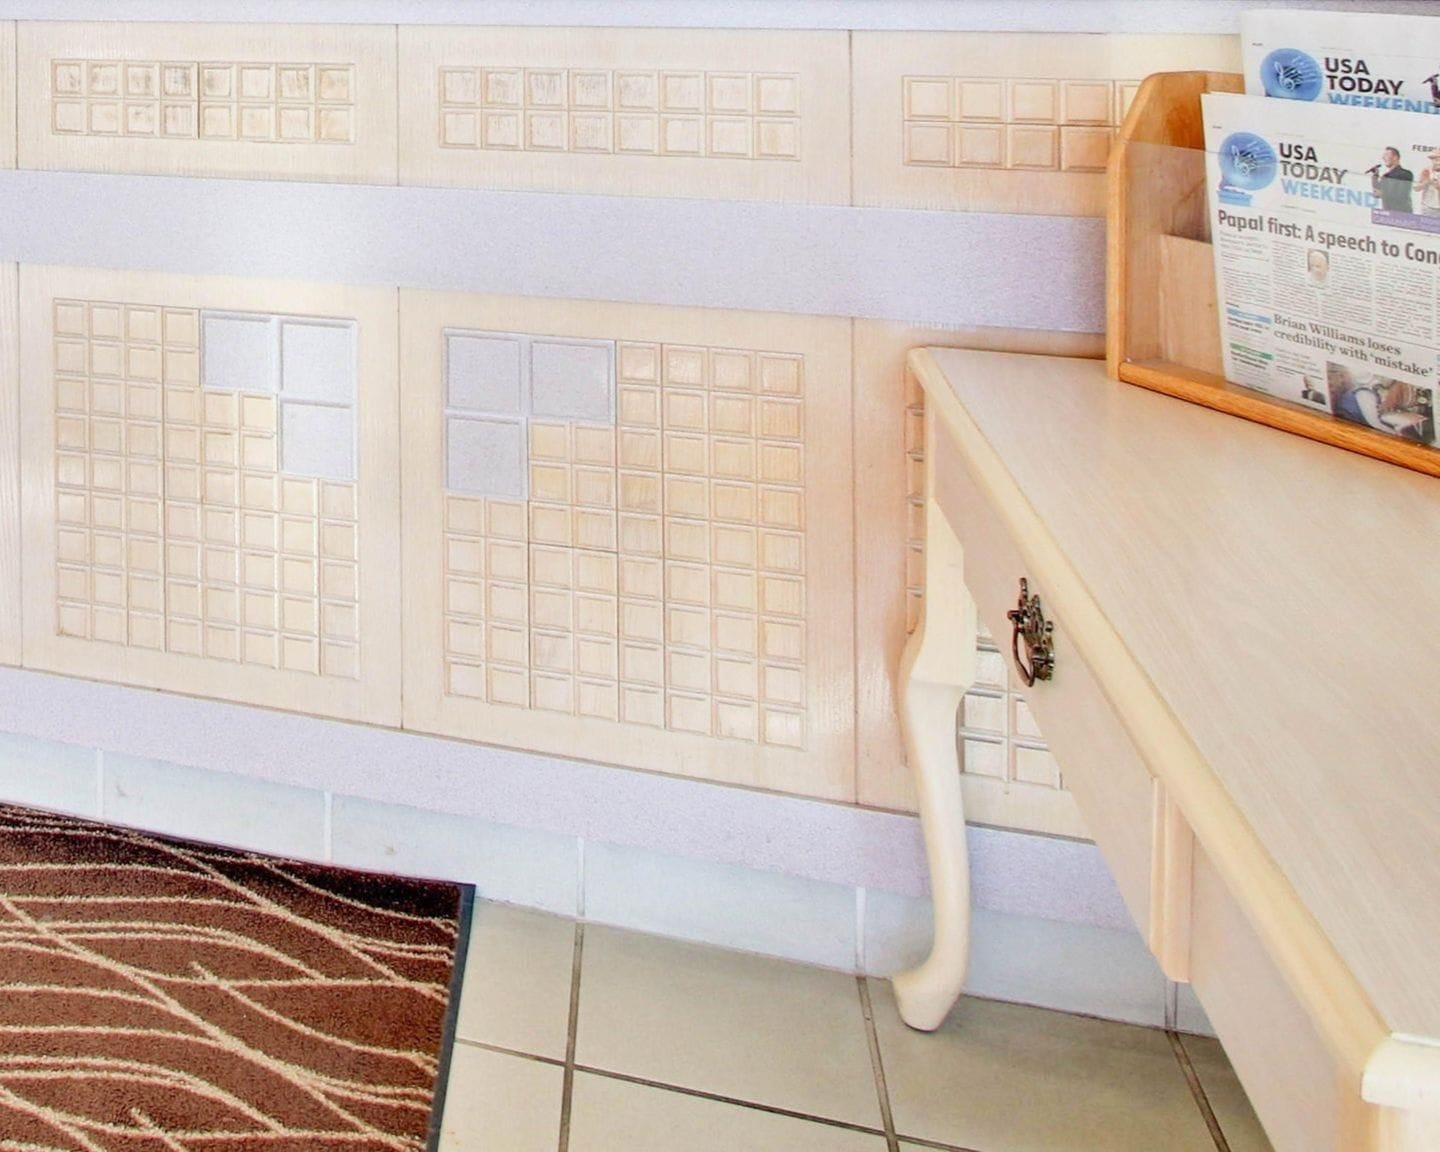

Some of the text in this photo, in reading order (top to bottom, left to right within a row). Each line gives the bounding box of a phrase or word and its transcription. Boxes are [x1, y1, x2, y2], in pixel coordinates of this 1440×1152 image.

[1324, 57, 1370, 75] USA
[1326, 75, 1404, 96] TODAY
[1279, 142, 1318, 163] USA
[1280, 160, 1348, 185] TODAY
[1280, 178, 1379, 209] WEEKEND
[1218, 209, 1262, 233] Papal
[1267, 217, 1302, 239] first:
[1304, 225, 1315, 242] A
[1318, 230, 1376, 254] speech
[1382, 240, 1400, 258] to
[1273, 313, 1307, 331] Brian
[1309, 323, 1366, 347] Williams
[1367, 336, 1401, 356] loses
[1273, 329, 1336, 355] credibility
[1338, 345, 1368, 362] with
